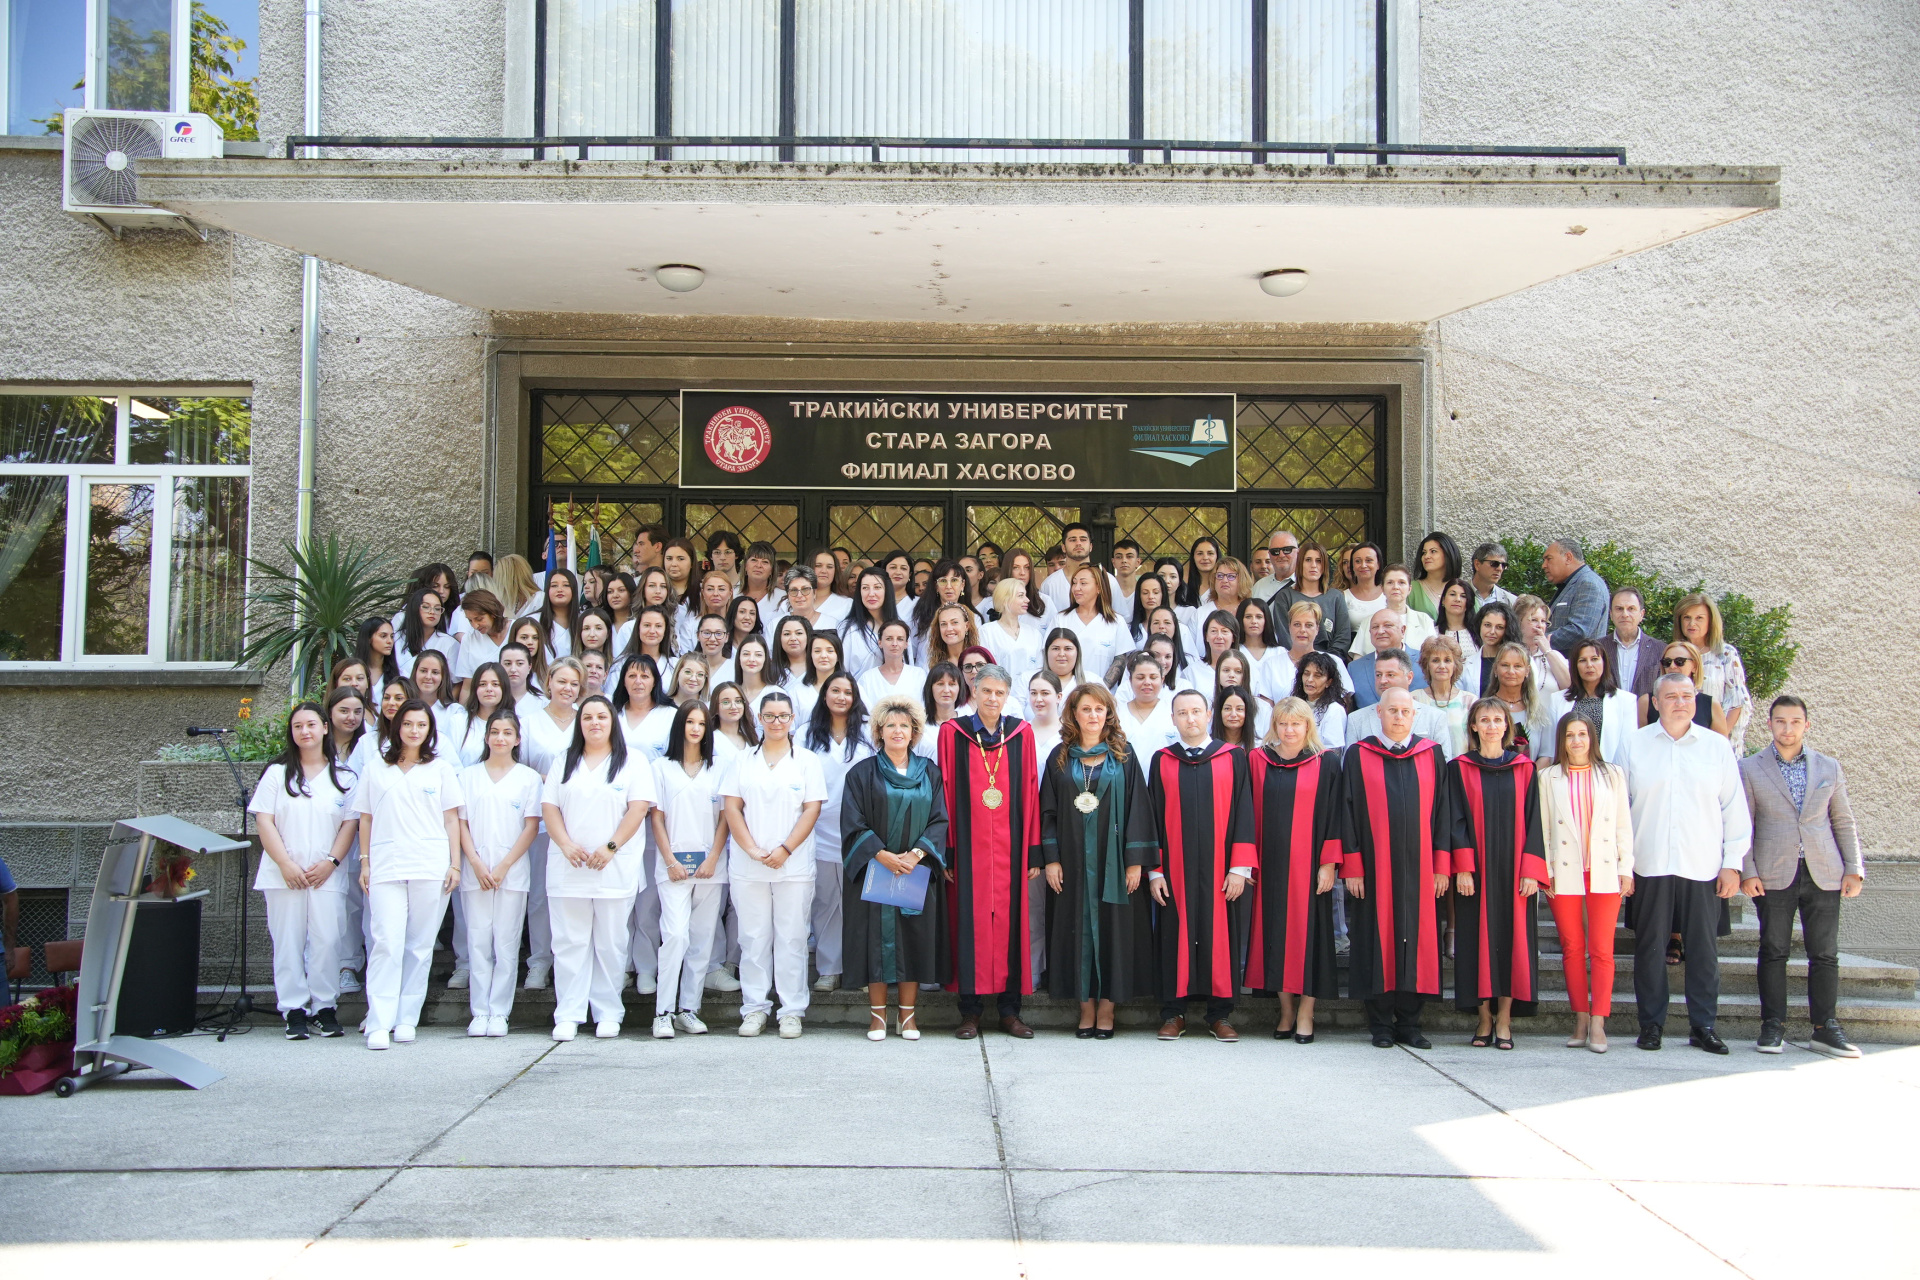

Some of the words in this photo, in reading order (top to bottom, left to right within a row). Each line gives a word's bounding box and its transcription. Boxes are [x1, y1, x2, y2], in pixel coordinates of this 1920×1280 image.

[789, 398, 939, 419] ТРАКИЙСКИ
[947, 402, 1128, 421] УНИВЕРСИТЕТ
[866, 432, 948, 450] СТАРА
[954, 432, 1052, 450] ЗАГОРА
[1133, 433, 1160, 442] ФИЛИАЛ
[1161, 433, 1190, 442] ХАСКОВО
[840, 462, 948, 481] ФИЛИАЛ
[955, 463, 1076, 481] ХАСКОВО
